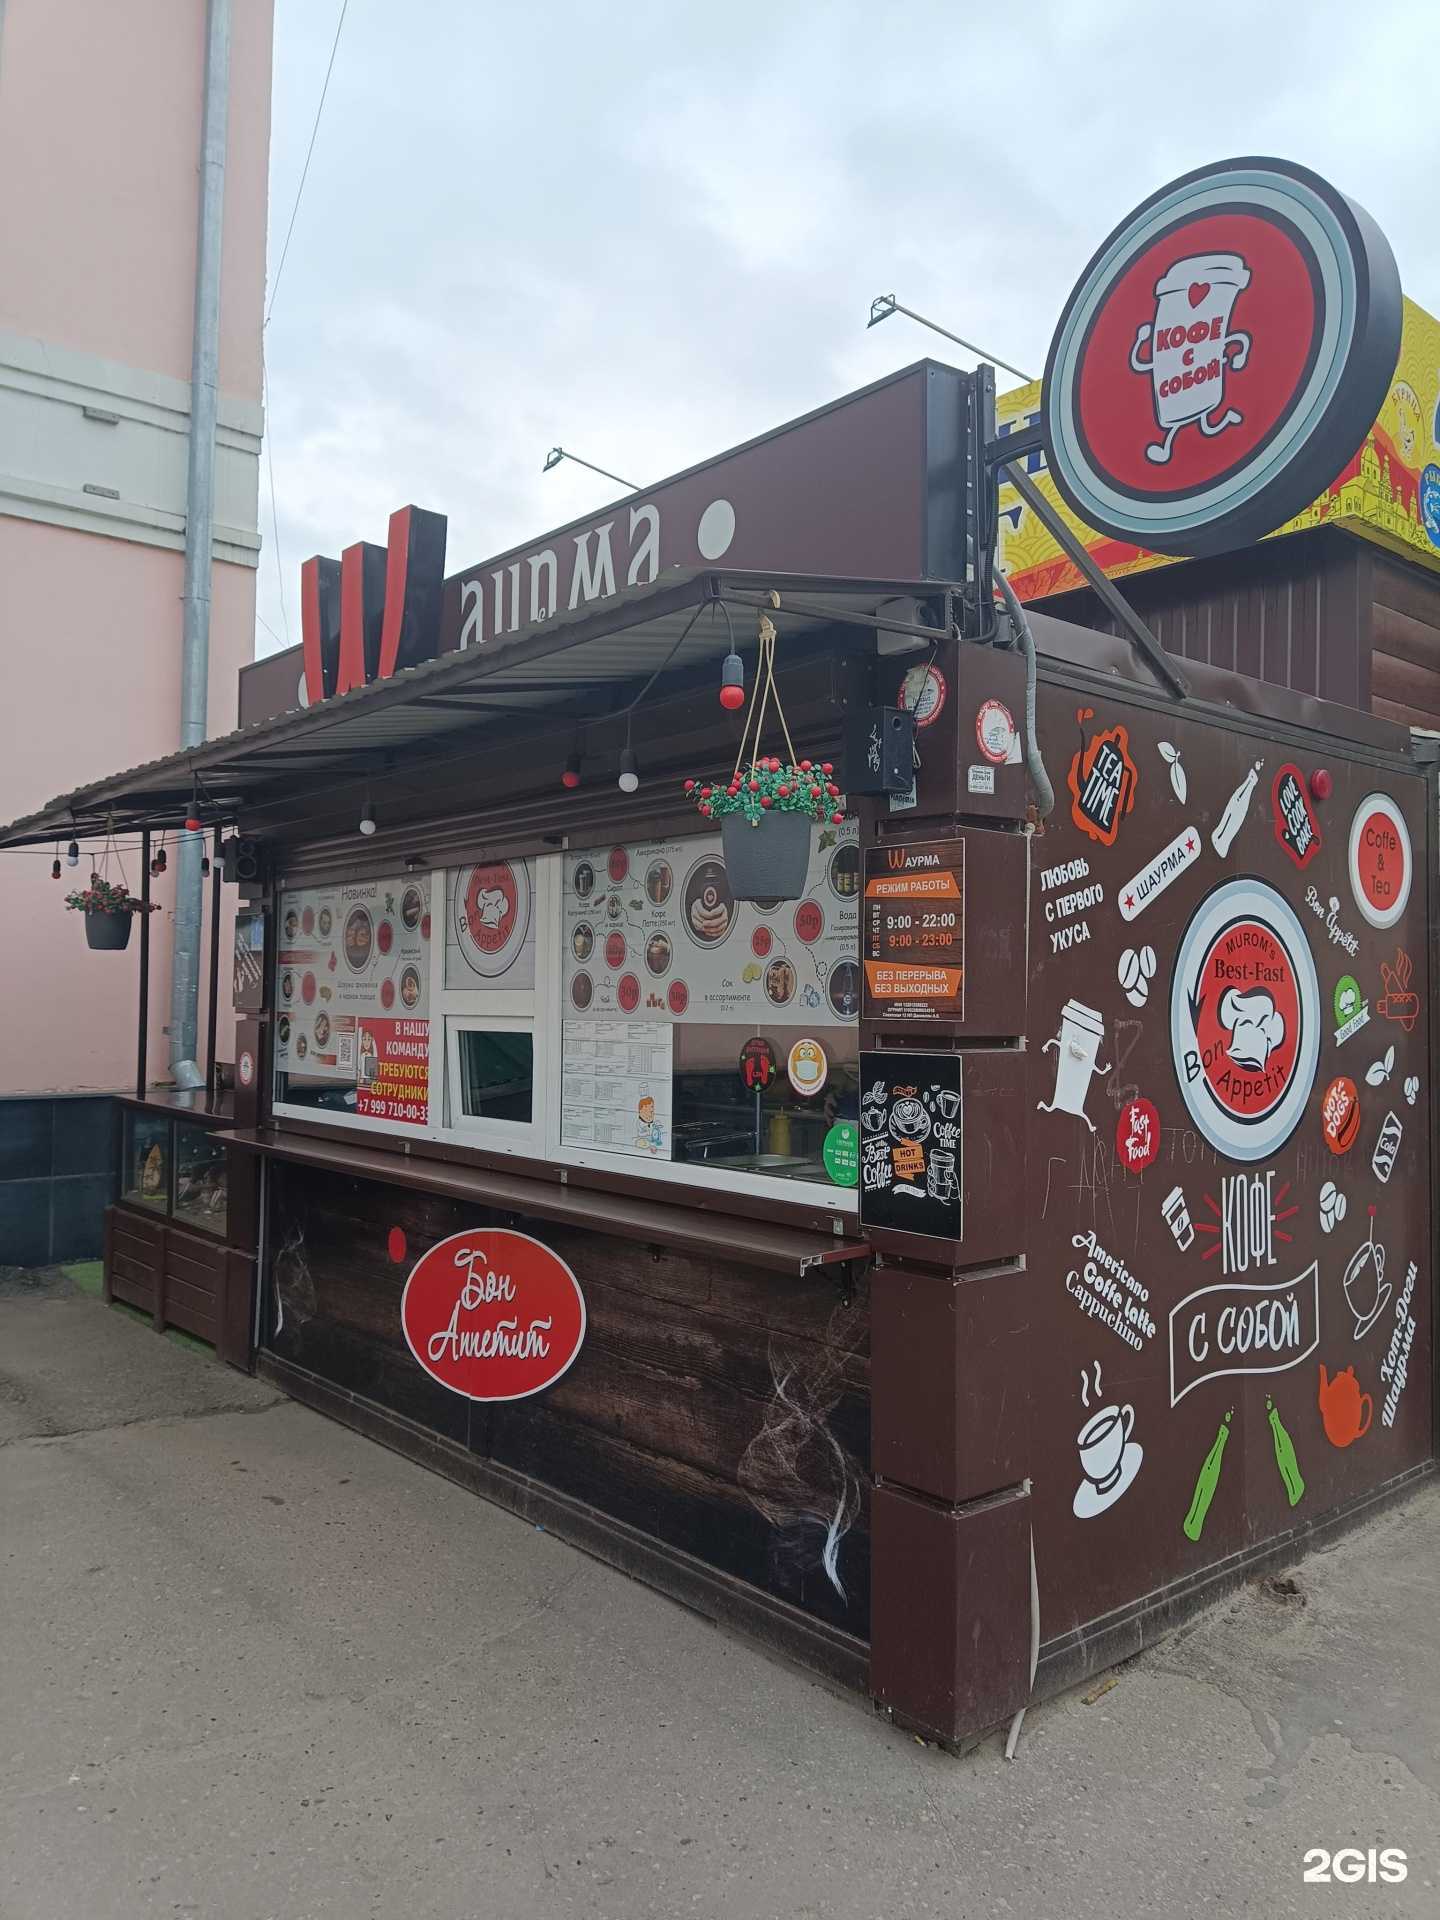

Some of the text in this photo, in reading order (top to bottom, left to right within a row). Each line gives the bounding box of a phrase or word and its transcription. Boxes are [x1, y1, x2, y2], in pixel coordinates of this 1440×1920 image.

[1156, 316, 1224, 352] КОФЕ
[1182, 348, 1194, 366] С
[1159, 359, 1220, 398] СОБОЙ
[1096, 744, 1123, 788] TEA
[1082, 766, 1120, 827] TIME
[1280, 775, 1300, 816] LOVE
[1288, 797, 1308, 834] COOK
[1366, 828, 1396, 851] Coffe
[1041, 857, 1090, 891] ЛЮБОВЬ
[1136, 847, 1186, 901] ШАУРМА
[1377, 853, 1385, 870] &
[876, 879, 950, 894] РЕЖИМ РАБОТЫ
[1371, 875, 1391, 895] Tea
[840, 911, 857, 921] Вода
[1045, 883, 1104, 922] С ПЕРВОГО
[1305, 885, 1326, 919] Bon
[887, 915, 912, 929] 9:00
[922, 913, 956, 928] 22:00
[889, 935, 912, 947] 9:00
[922, 933, 952, 946] 23:00
[1050, 921, 1091, 953] УКУСА
[877, 970, 947, 981] БЕЗ ПЕРЕРЫВА
[1214, 958, 1285, 983] Best-Fast
[875, 984, 949, 995] БЕЗ ВЫХОДНЫХ
[395, 1022, 429, 1037] В НАШУ
[386, 1041, 429, 1059] КОМАНДУ
[1184, 1039, 1225, 1083] Bon
[379, 1062, 429, 1080] ТРЕБУЮТСЯ
[1216, 1064, 1287, 1104] Appetit
[358, 1099, 368, 1112] +7
[371, 1101, 386, 1115] 999
[370, 1083, 428, 1101] СОТРУДНИКИ
[1129, 1106, 1150, 1137] Fast
[1327, 1090, 1350, 1138] DOGS
[933, 1122, 961, 1139] Coffee
[940, 1139, 957, 1148] TIME
[1380, 1138, 1396, 1153] Cola
[862, 1142, 891, 1164] Best
[900, 1149, 916, 1157] HOT
[1125, 1132, 1151, 1162] Food
[863, 1161, 893, 1189] Coffee
[896, 1162, 924, 1171] DRINKS
[1222, 1171, 1277, 1274] КОФЕ
[454, 1248, 517, 1310] Бон
[1072, 1230, 1149, 1302] Americano
[1084, 1262, 1122, 1308] Coffe
[1066, 1270, 1143, 1351] Cappuchino
[427, 1299, 552, 1361] Аппетит
[1188, 1294, 1300, 1362] С СОБОЙ
[1382, 1315, 1416, 1428] Шаурма
